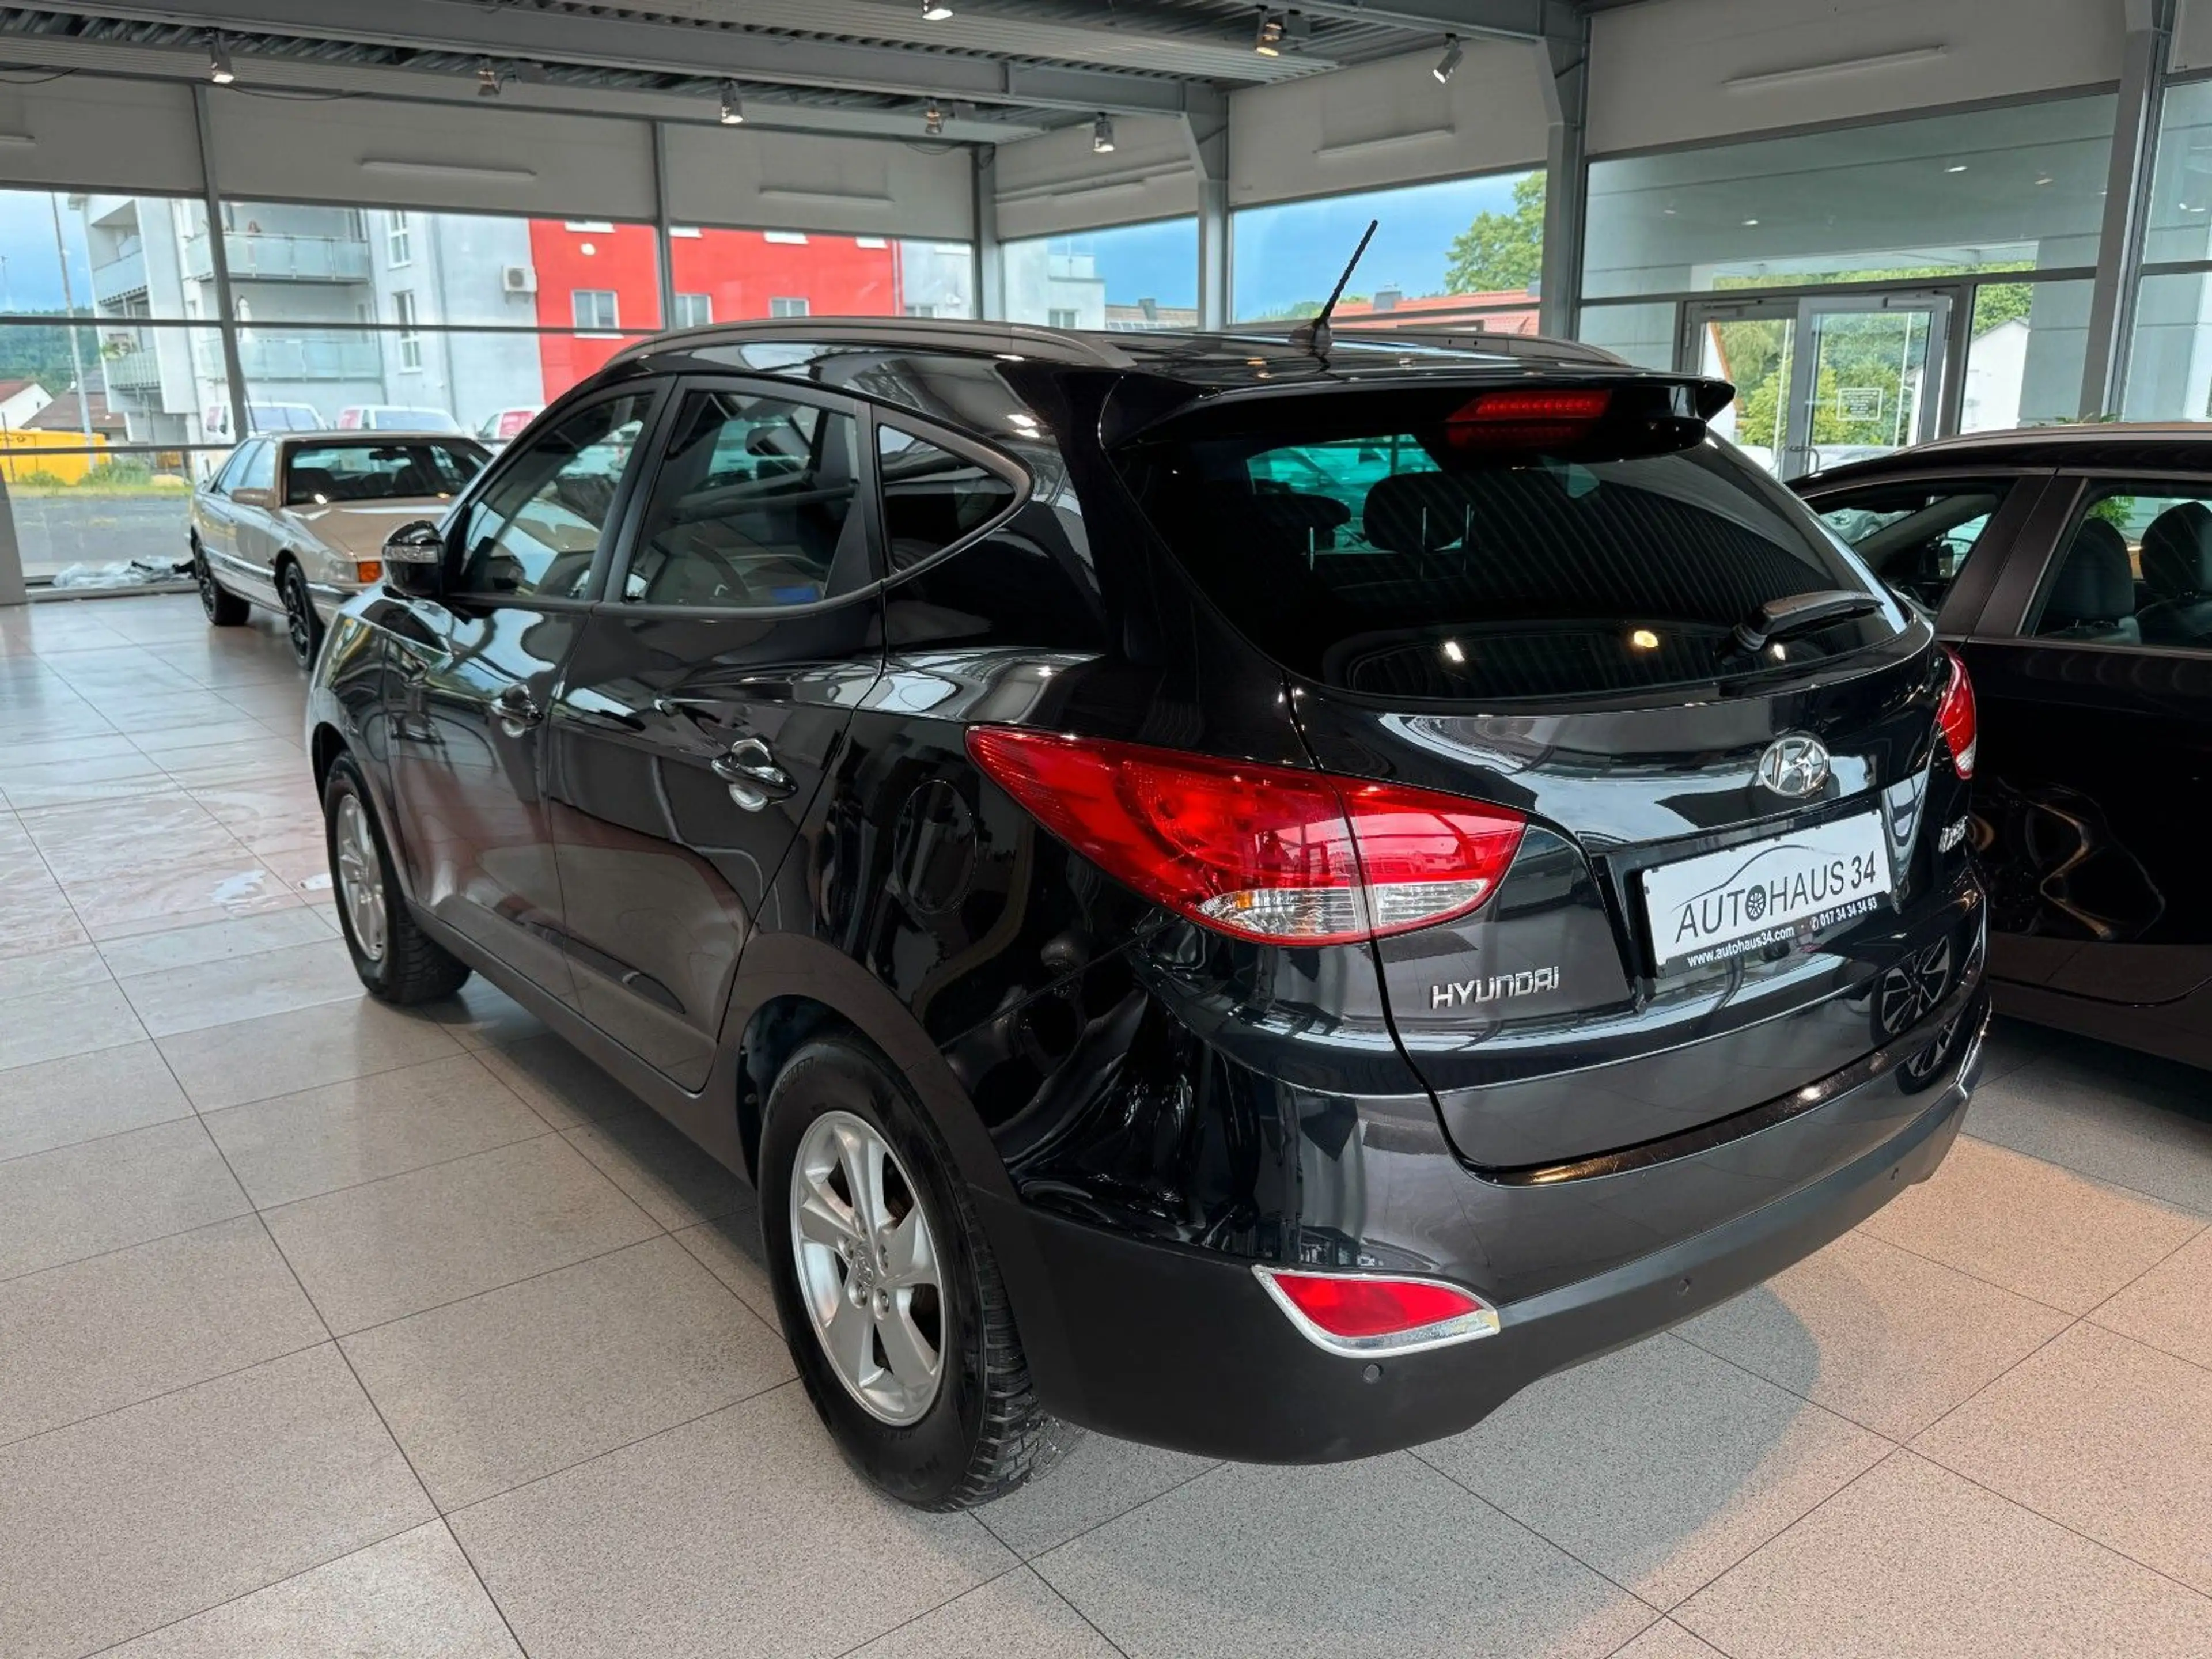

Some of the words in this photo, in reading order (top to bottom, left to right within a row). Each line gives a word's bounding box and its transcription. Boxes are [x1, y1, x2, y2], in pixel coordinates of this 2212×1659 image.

[1675, 860, 1844, 944] AUTOHAUS
[1850, 851, 1876, 889] 34
[1687, 926, 1794, 967] www.autohaus34.com
[1819, 911, 1834, 927] 017
[1836, 906, 1846, 922] 34
[1847, 903, 1857, 918] 34
[1857, 899, 1867, 915] 34
[1431, 966, 1559, 1009] HYUNDAI
